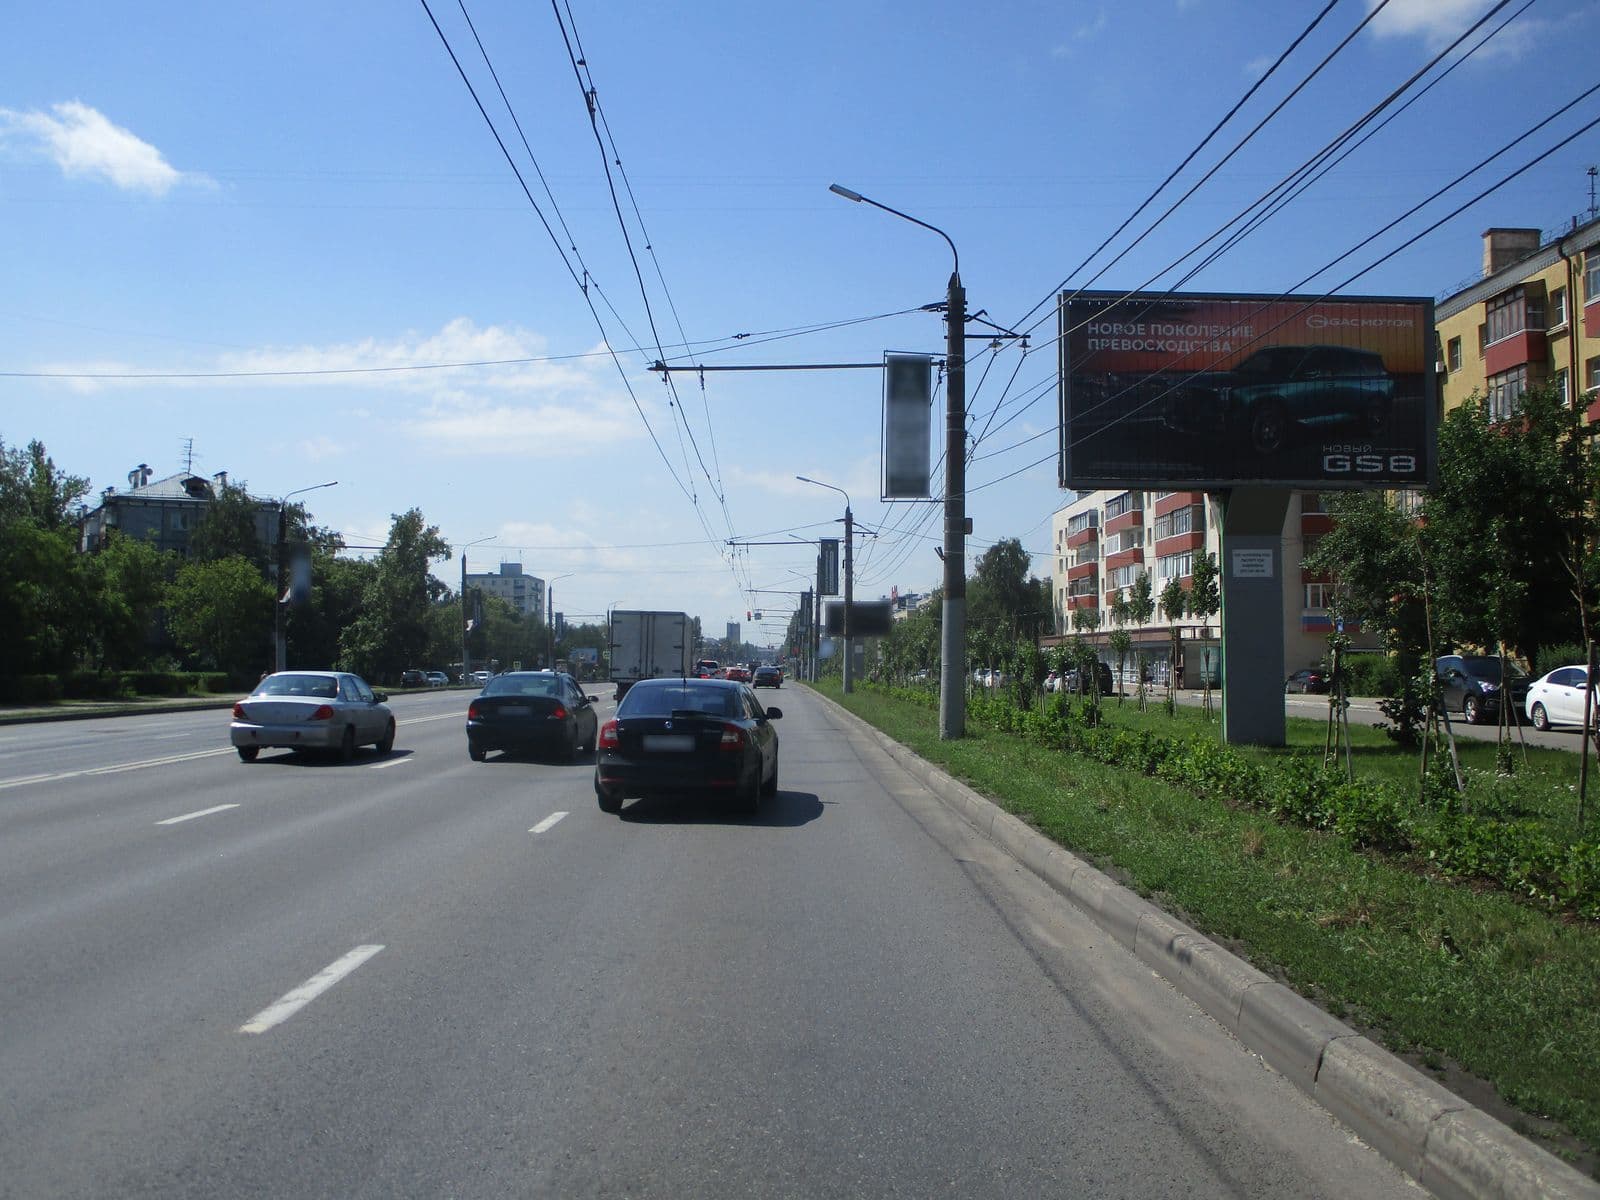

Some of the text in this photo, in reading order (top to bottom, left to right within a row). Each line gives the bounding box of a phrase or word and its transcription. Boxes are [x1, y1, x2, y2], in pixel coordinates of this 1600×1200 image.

[1087, 322, 1254, 338] НОВОЕ ПОКОЛЕНИЕ
[1087, 338, 1232, 353] ПРЕВОСХОДСТВА
[1323, 454, 1416, 473] GS8
